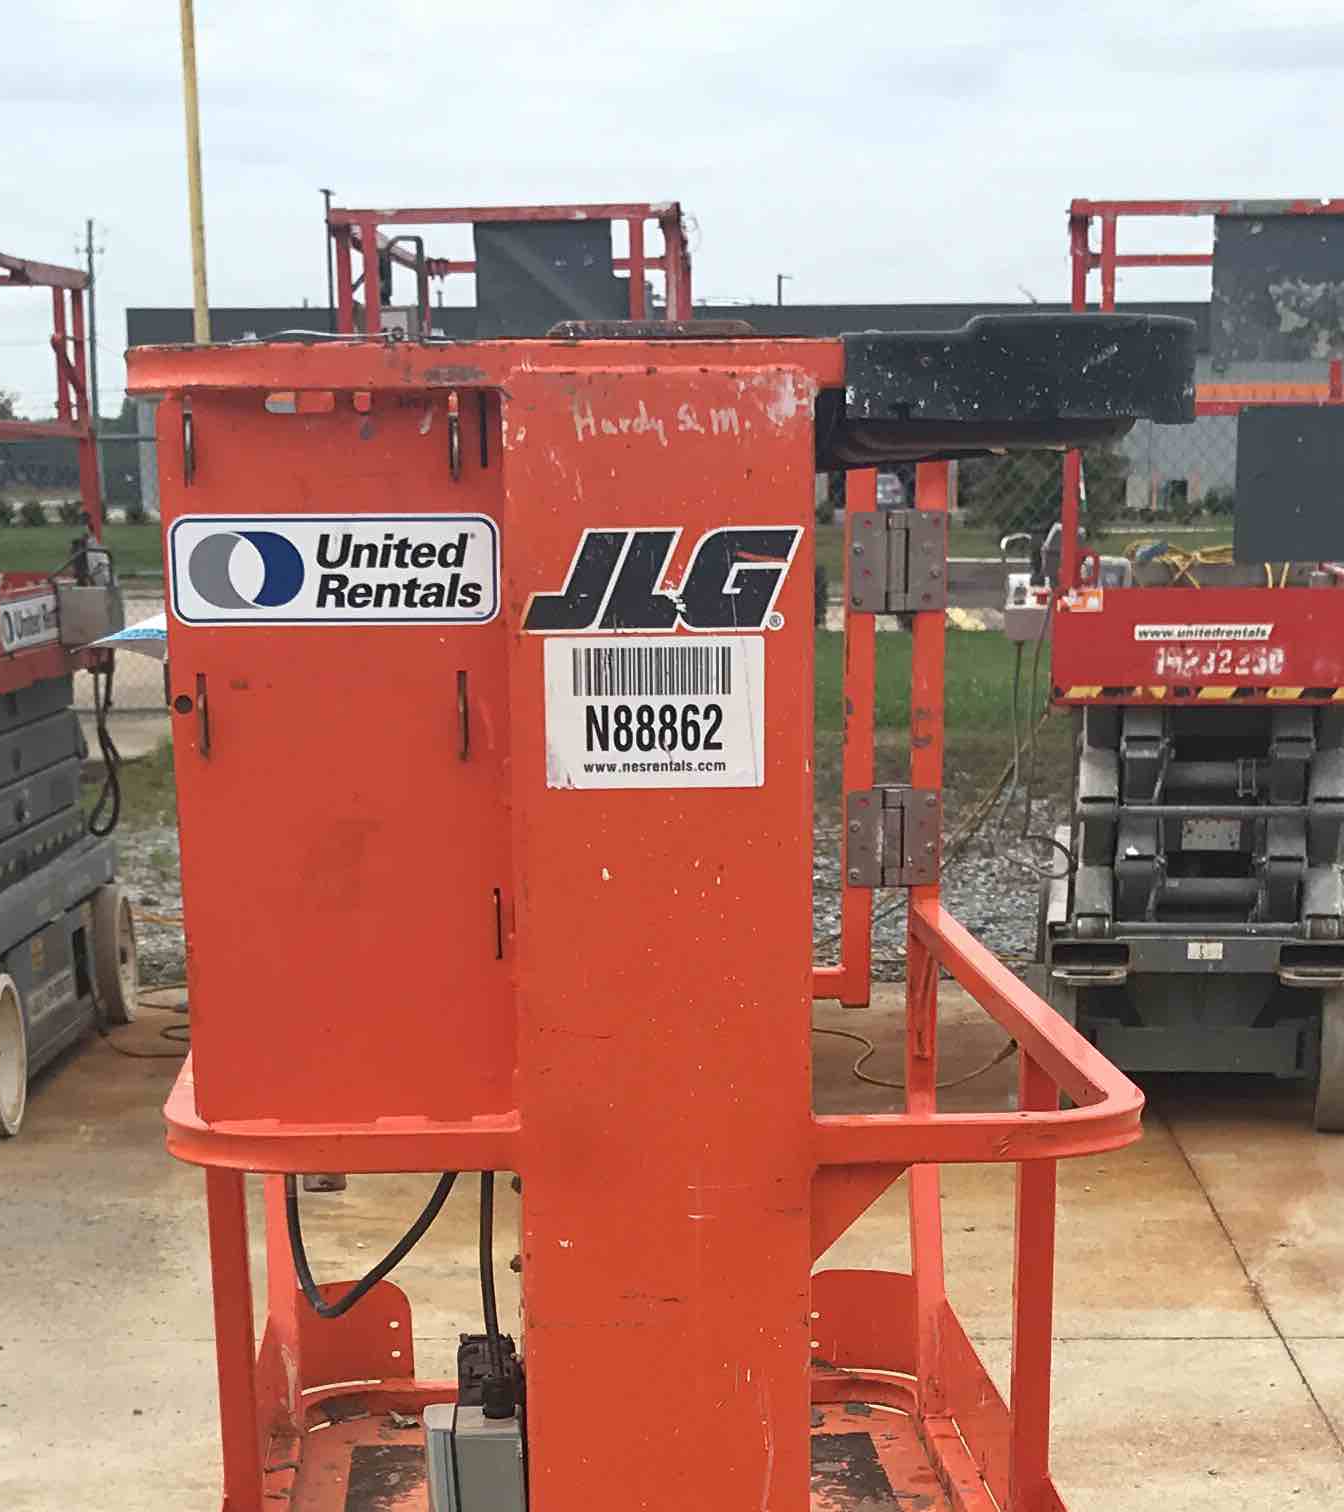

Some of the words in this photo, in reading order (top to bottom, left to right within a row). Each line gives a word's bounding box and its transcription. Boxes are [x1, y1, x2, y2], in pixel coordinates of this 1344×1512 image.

[315, 533, 468, 569] United
[315, 573, 482, 608] Rentals
[523, 526, 804, 633] JLG
[585, 703, 723, 752] N88862
